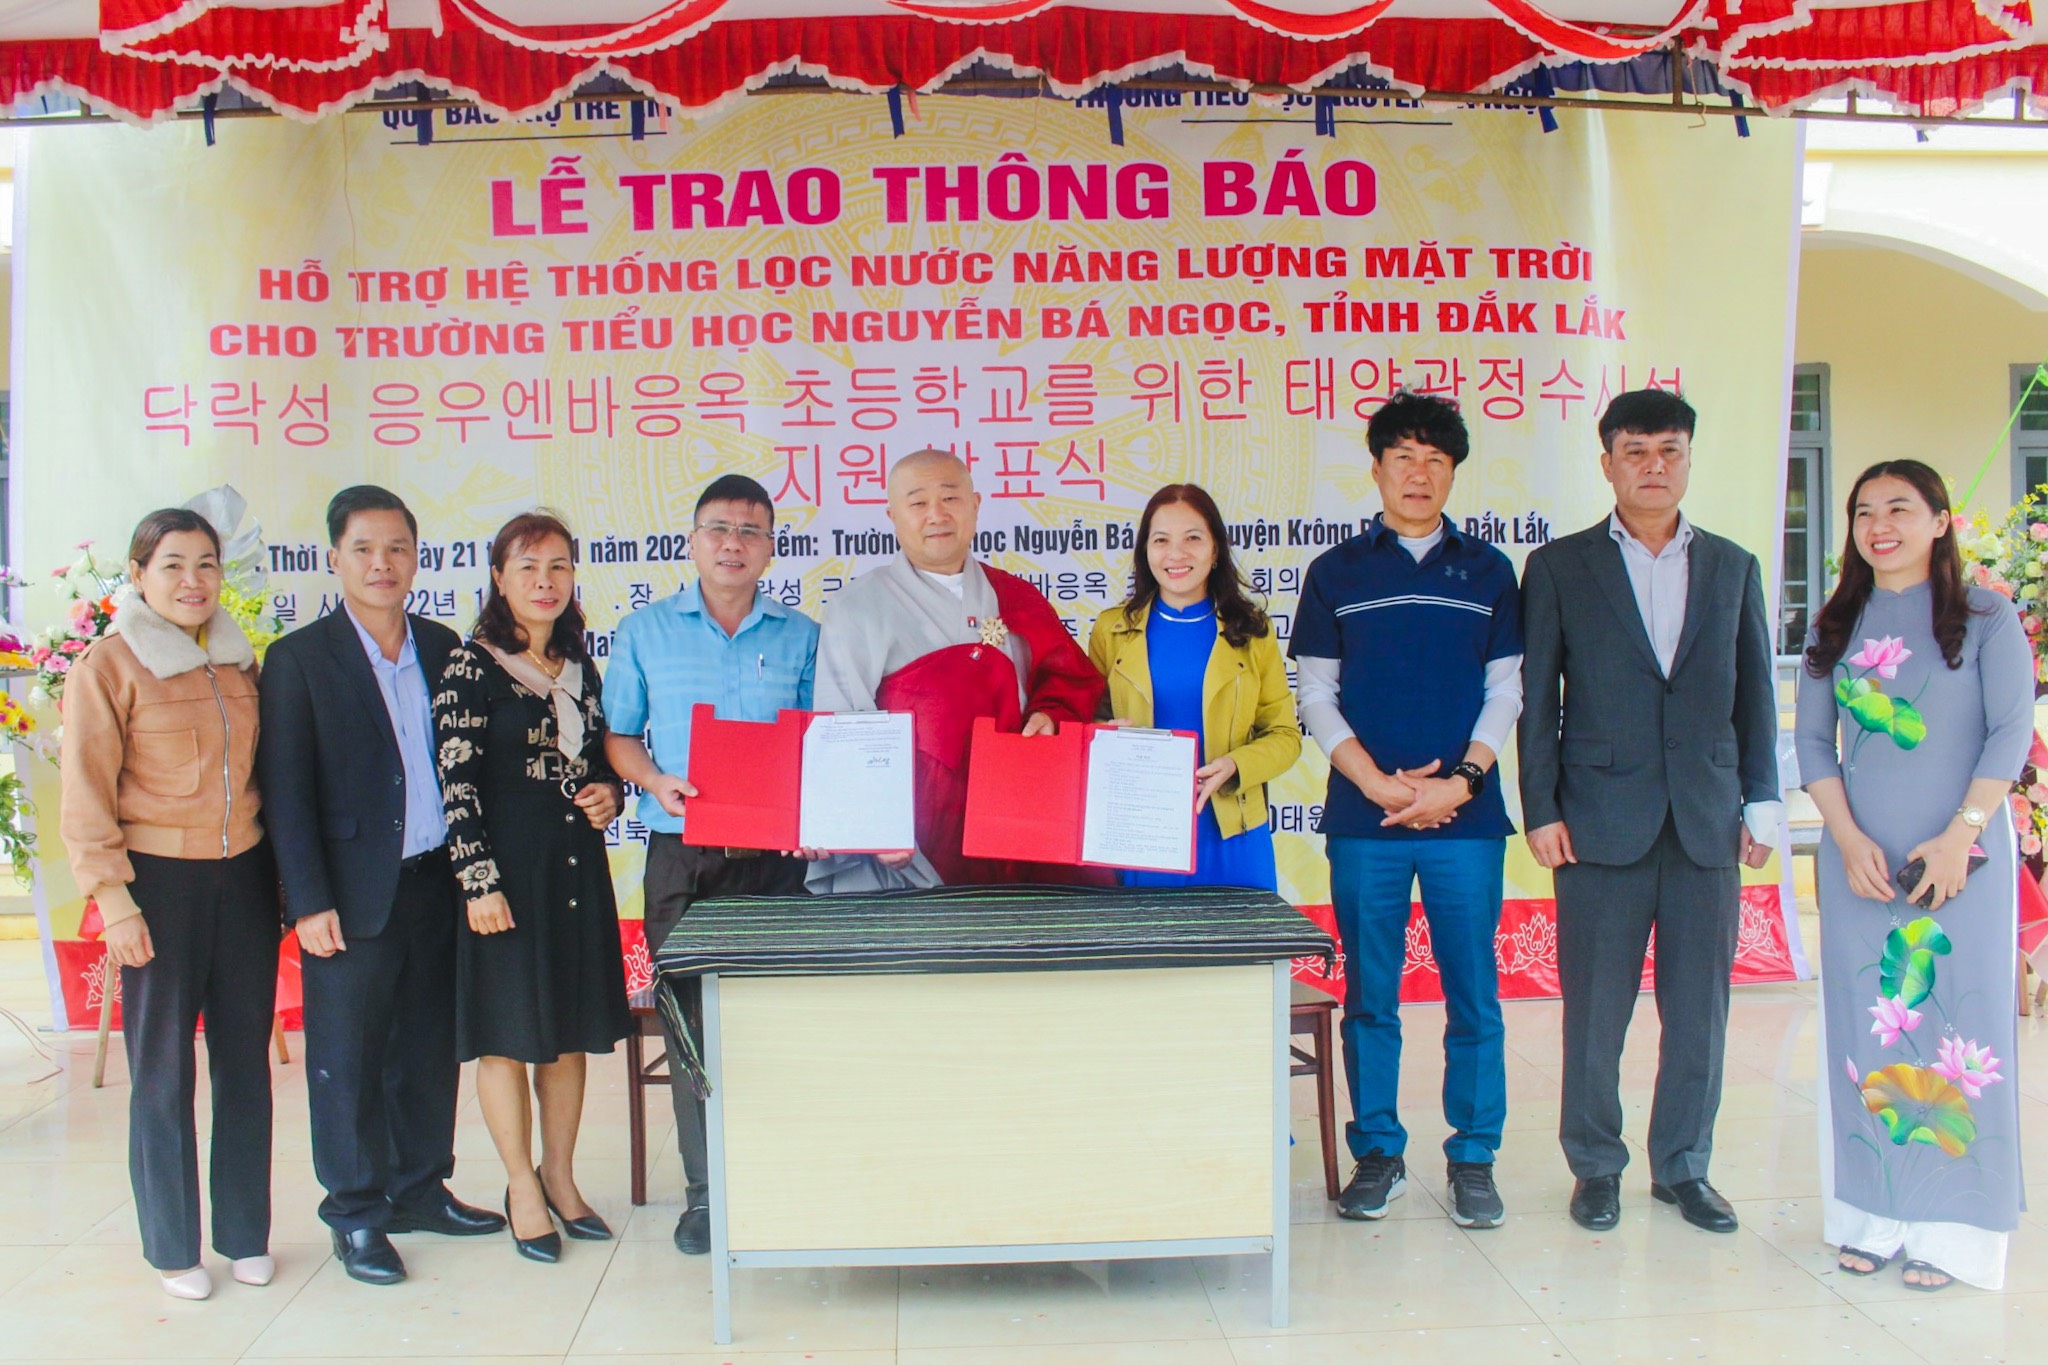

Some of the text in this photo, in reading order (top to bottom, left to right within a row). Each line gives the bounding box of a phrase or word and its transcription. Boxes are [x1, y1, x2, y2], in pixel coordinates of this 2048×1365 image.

[491, 148, 1376, 236] LỄ TRAO THÔNG BÁO
[260, 241, 1591, 307] HỖ TRỢ HỆ THỐNG LỌC NƯỚC NĂNG LƯỢNG MẶT TRỜI
[211, 289, 1627, 357] CHO TRƯỜNG TIỂU HỌC NGUYỄN BÁ NGỌC, TỈNH ĐẮK LẮK
[143, 380, 331, 448] 닥락성
[368, 371, 749, 447] 응우엔바응옥
[781, 362, 1098, 431] 초등학교를
[1132, 359, 1252, 422] 위한
[268, 544, 318, 572] Thời
[452, 541, 476, 568] 21
[590, 536, 638, 563] năm
[832, 528, 900, 556] Trườn
[1014, 519, 1098, 555] Nguyễn
[1106, 523, 1134, 550] Bá
[1465, 511, 1506, 544] Đắk
